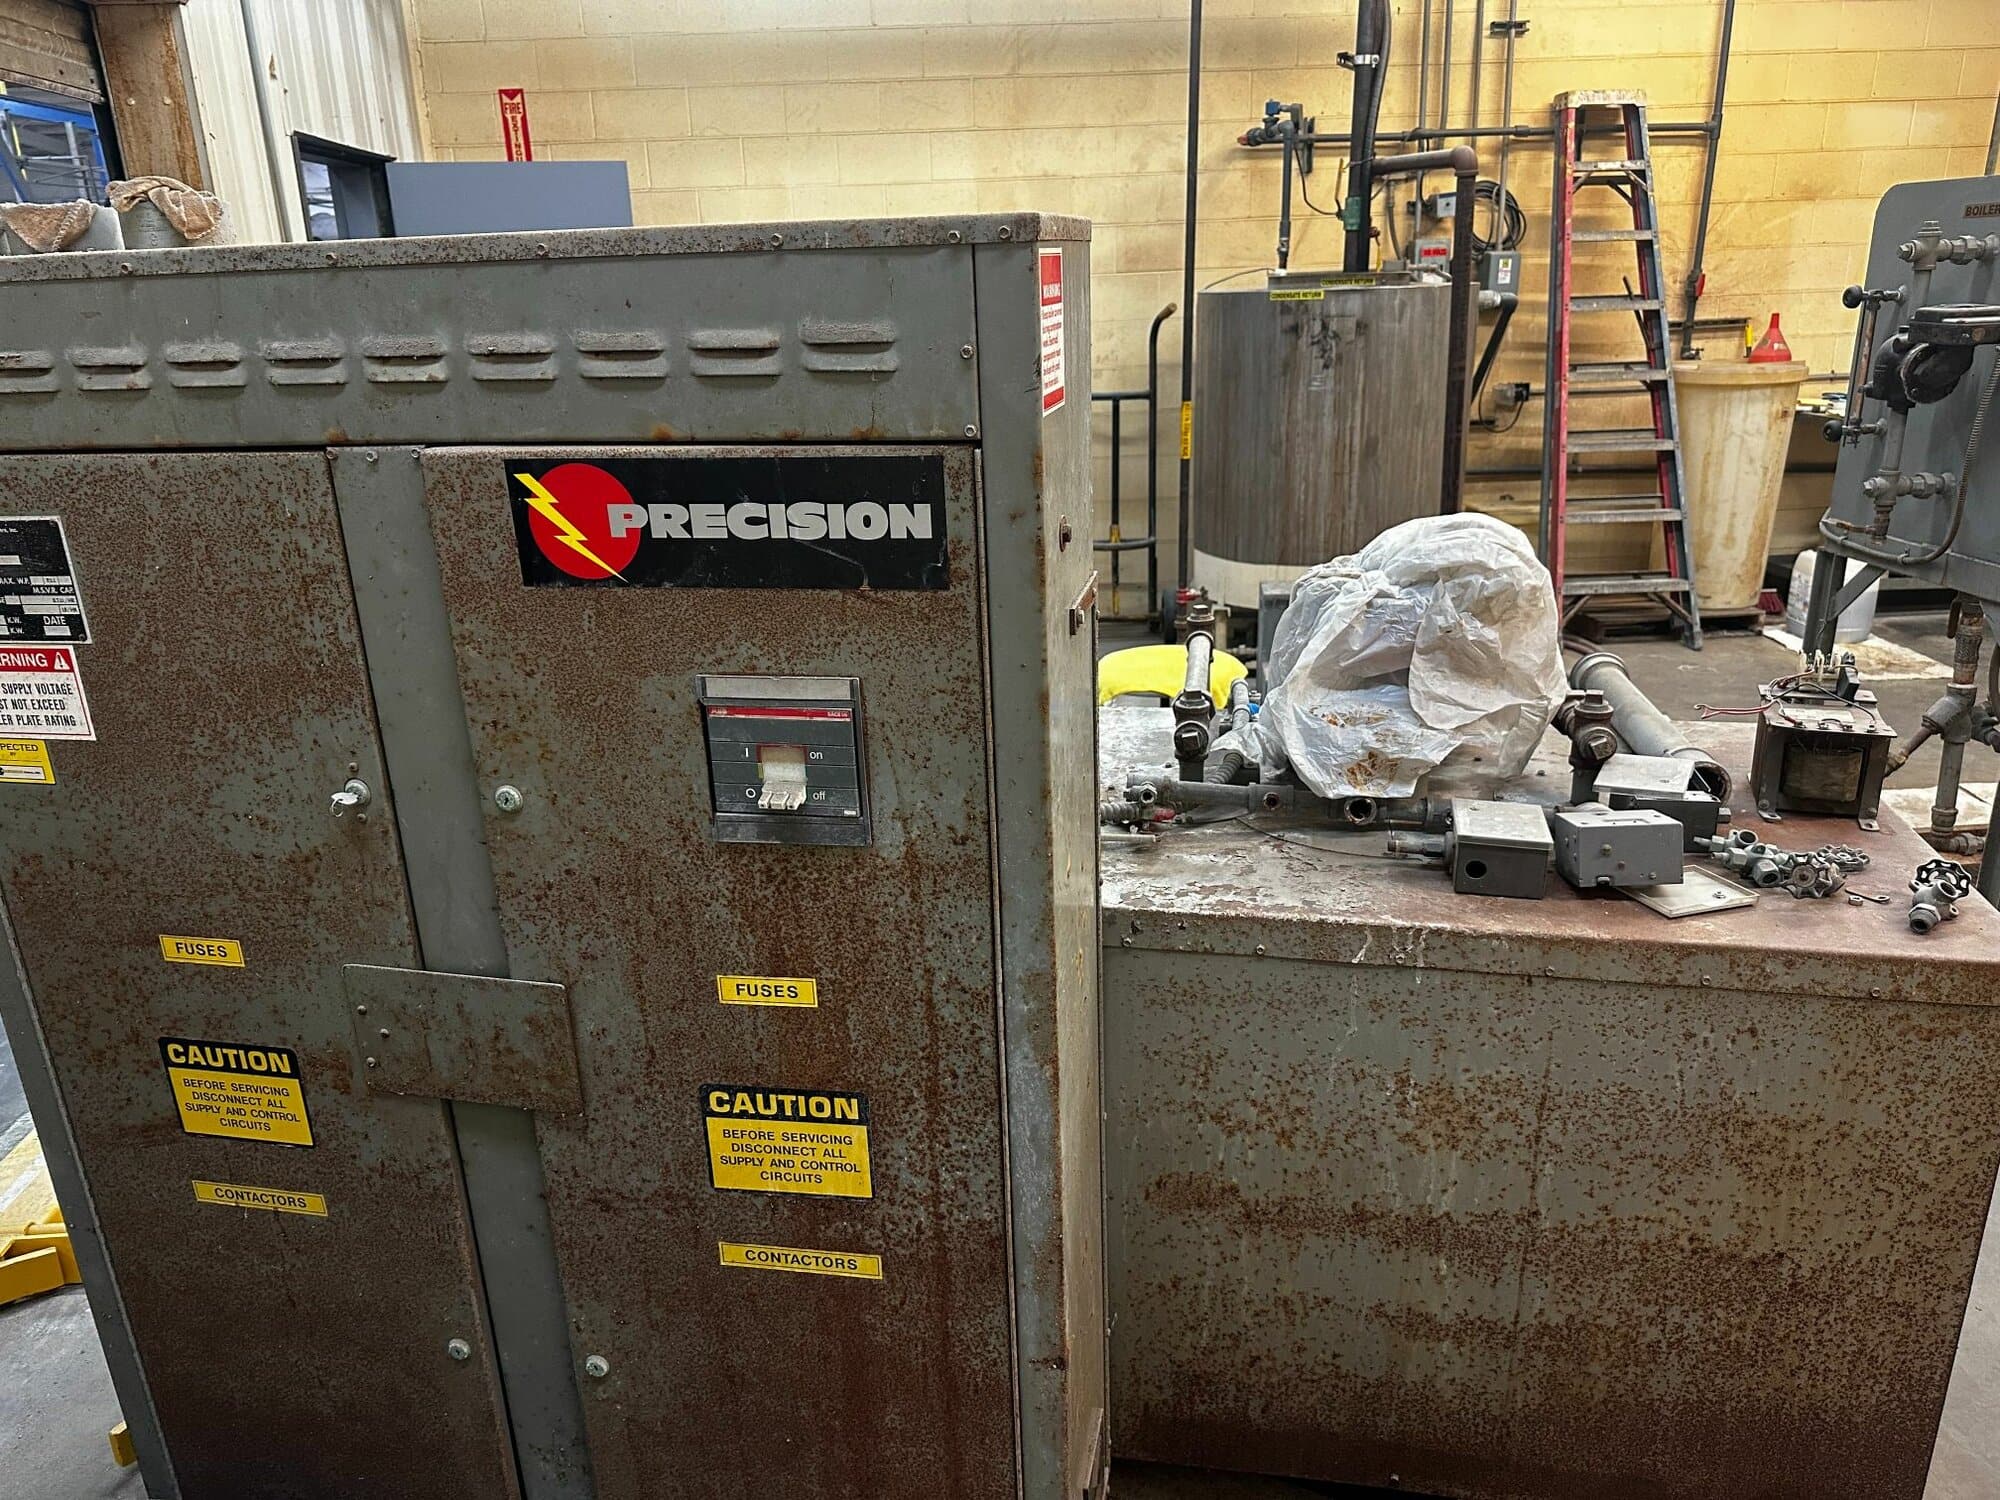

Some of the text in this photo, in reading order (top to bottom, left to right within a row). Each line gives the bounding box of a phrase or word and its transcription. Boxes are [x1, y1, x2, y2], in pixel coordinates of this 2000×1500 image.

[504, 103, 521, 114] FIRE
[1966, 204, 2000, 217] BOILER
[606, 501, 933, 541] PRECISION
[43, 615, 67, 625] DATE
[3, 683, 73, 695] SUPPLY VOLTAGE
[12, 699, 28, 710] NOT
[32, 699, 66, 711] EXCEED
[16, 715, 42, 726] PLATE
[44, 715, 77, 726] RATING
[809, 751, 823, 760] on
[812, 791, 826, 800] off
[175, 942, 227, 958] FUSES
[735, 983, 799, 998] FUSES
[167, 1043, 292, 1074] CAUTION
[183, 1078, 289, 1097] BEFORE SERVICING
[192, 1091, 287, 1108] DISCONNECT ALL
[708, 1091, 859, 1120] CAUTION
[185, 1102, 300, 1122] SUPPLY AND CONTROL
[219, 1118, 271, 1131] CIRCUITS
[722, 1129, 853, 1145] BEFORE SERVICING
[731, 1143, 847, 1159] DISCONNECT ALL
[720, 1155, 861, 1173] SUPPLY AND CONTROL
[760, 1171, 823, 1184] CIRCUITS
[214, 1187, 307, 1208] CONTACTORS
[745, 1249, 858, 1271] CONTACTORS
